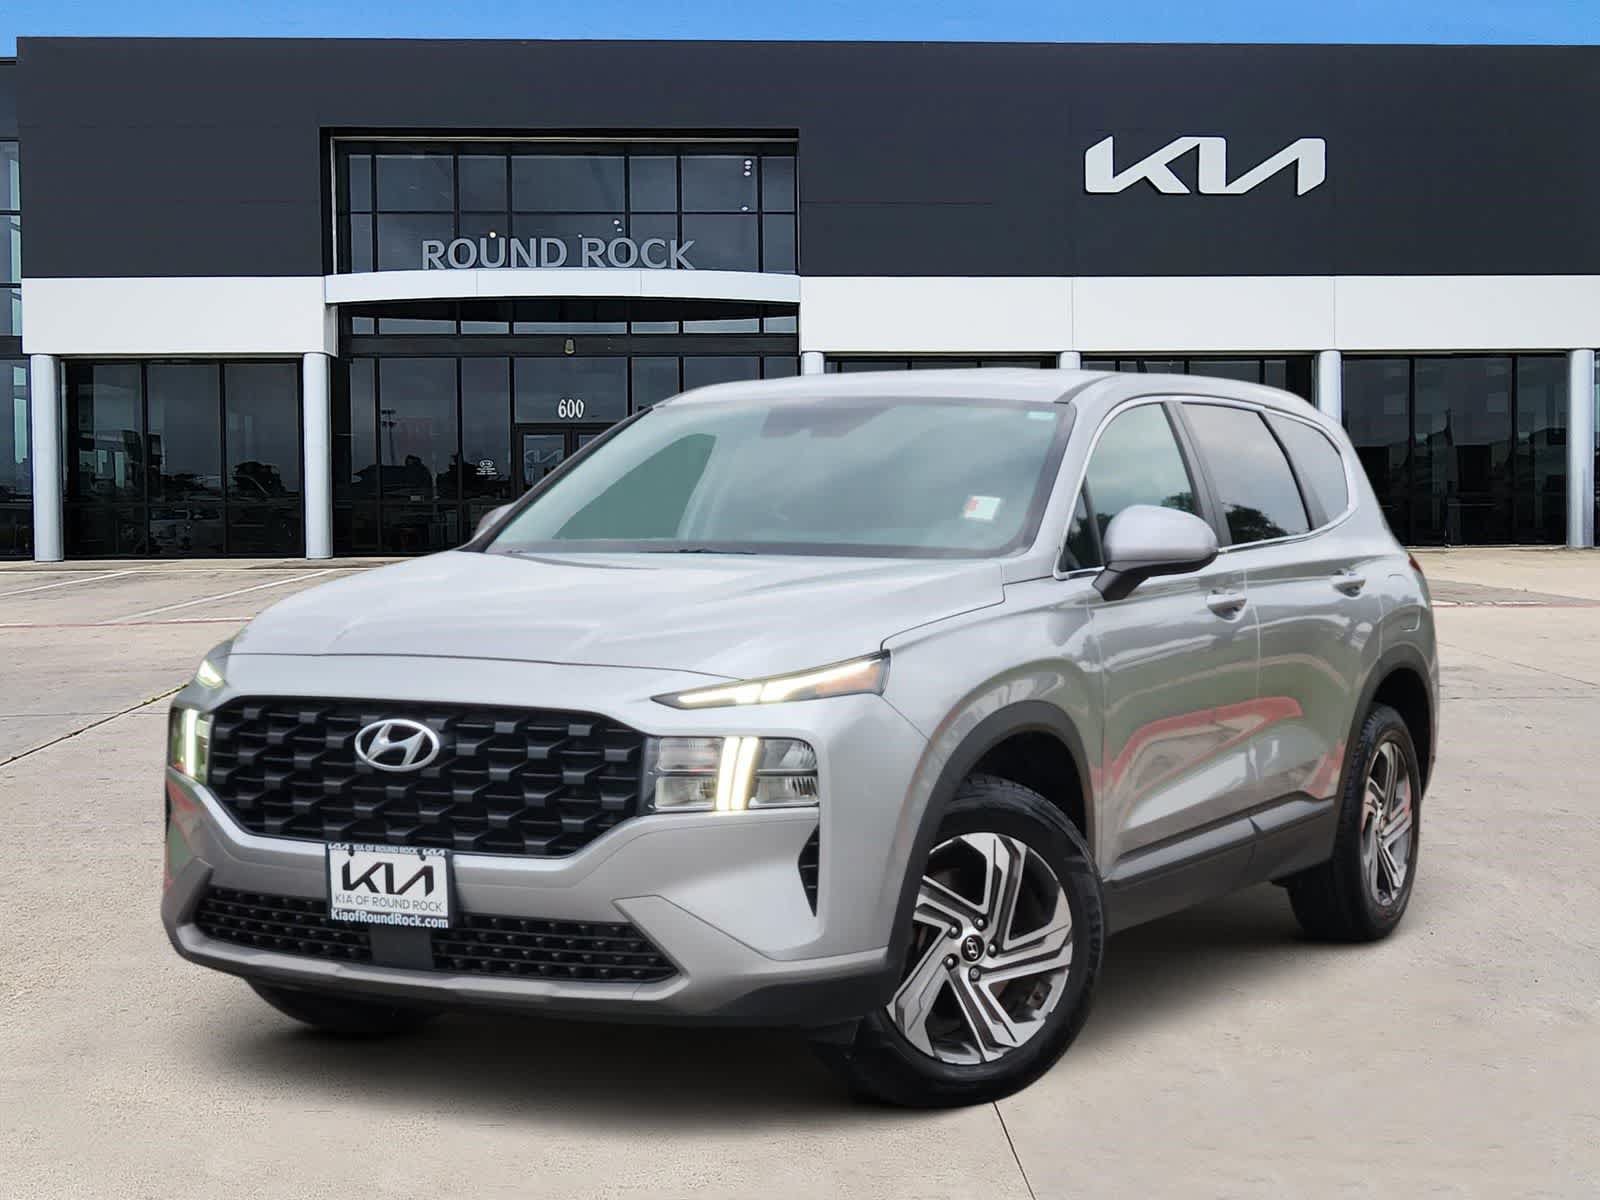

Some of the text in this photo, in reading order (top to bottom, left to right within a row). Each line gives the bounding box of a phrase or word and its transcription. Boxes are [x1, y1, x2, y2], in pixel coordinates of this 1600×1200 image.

[1085, 135, 1326, 196] KIA
[422, 236, 695, 269] ROUND ROCK
[558, 399, 585, 418] 600
[342, 860, 434, 897] KIA
[335, 894, 442, 913] KIA OF ROUND ROCK
[331, 909, 449, 928] KiaofRoundRock.com
